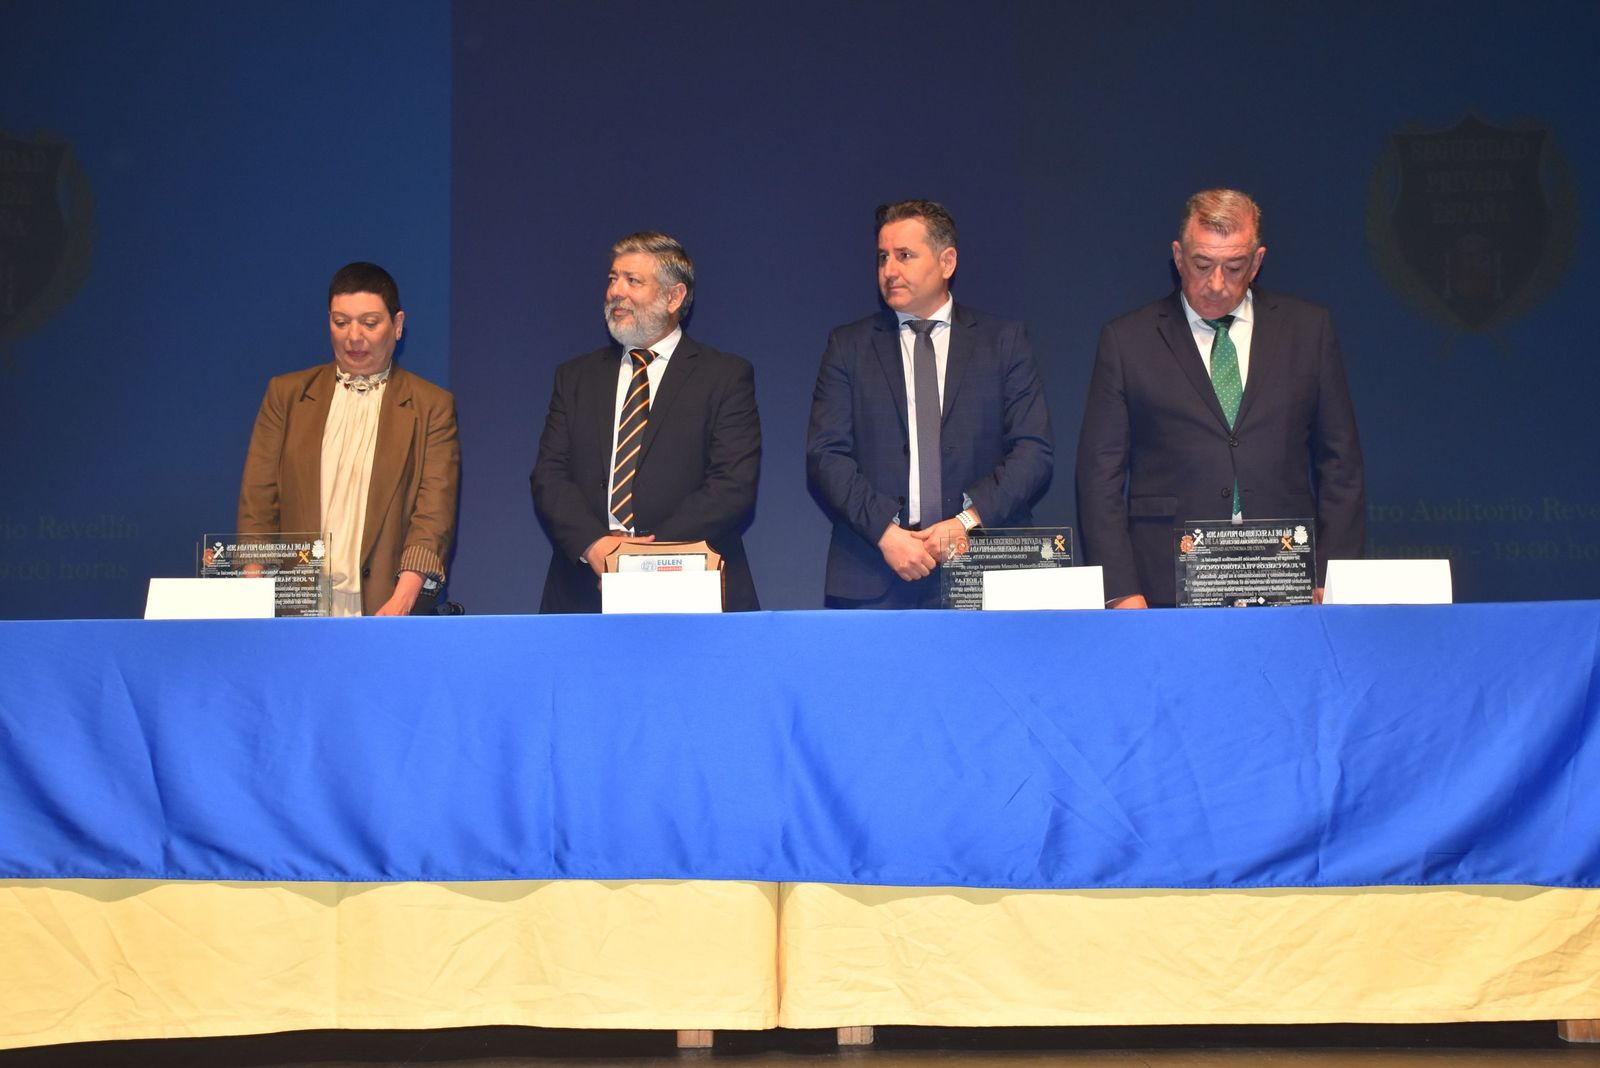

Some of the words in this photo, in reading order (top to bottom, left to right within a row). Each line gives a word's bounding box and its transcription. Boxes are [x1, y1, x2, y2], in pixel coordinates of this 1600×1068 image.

[1425, 169, 1515, 192] PRIVADA
[1410, 497, 1533, 522] Auditorio
[38, 513, 140, 540] Revellín
[58, 553, 130, 580] horas
